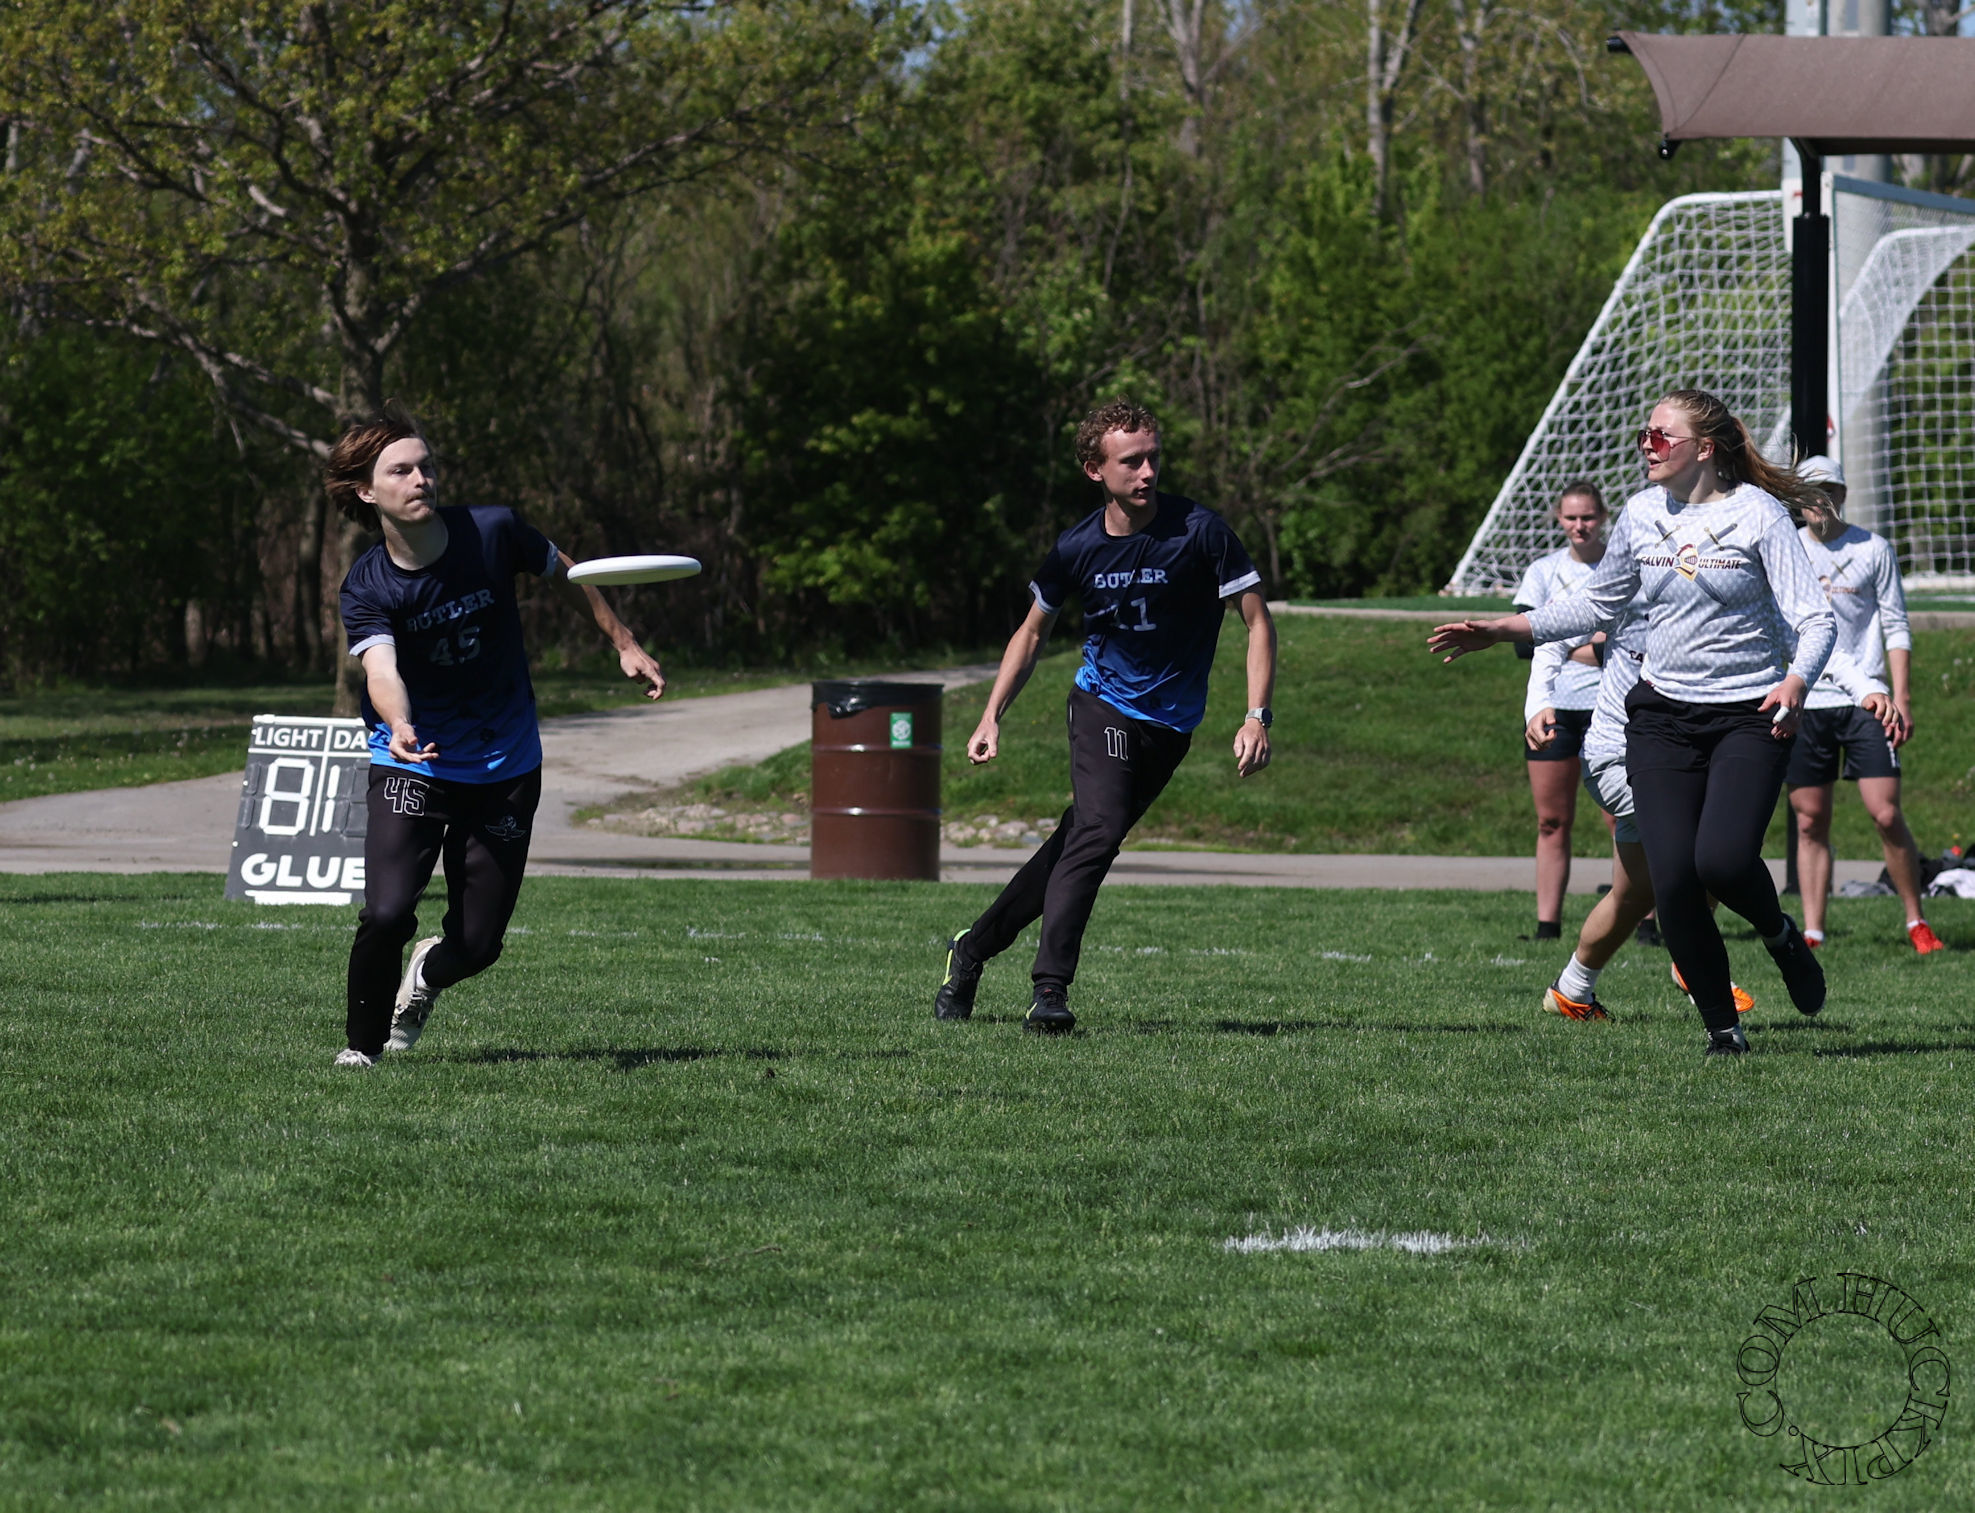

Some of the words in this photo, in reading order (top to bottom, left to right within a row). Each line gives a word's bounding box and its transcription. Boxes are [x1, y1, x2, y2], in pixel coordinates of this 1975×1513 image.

[1094, 568, 1168, 588] BUTER
[1698, 558, 1742, 570] ULTIMATE
[429, 625, 481, 666] 45
[254, 727, 324, 748] LIGHT
[333, 730, 373, 749] DA
[1104, 726, 1129, 761] 11
[384, 777, 430, 816] 45
[240, 853, 366, 890] GLUE
